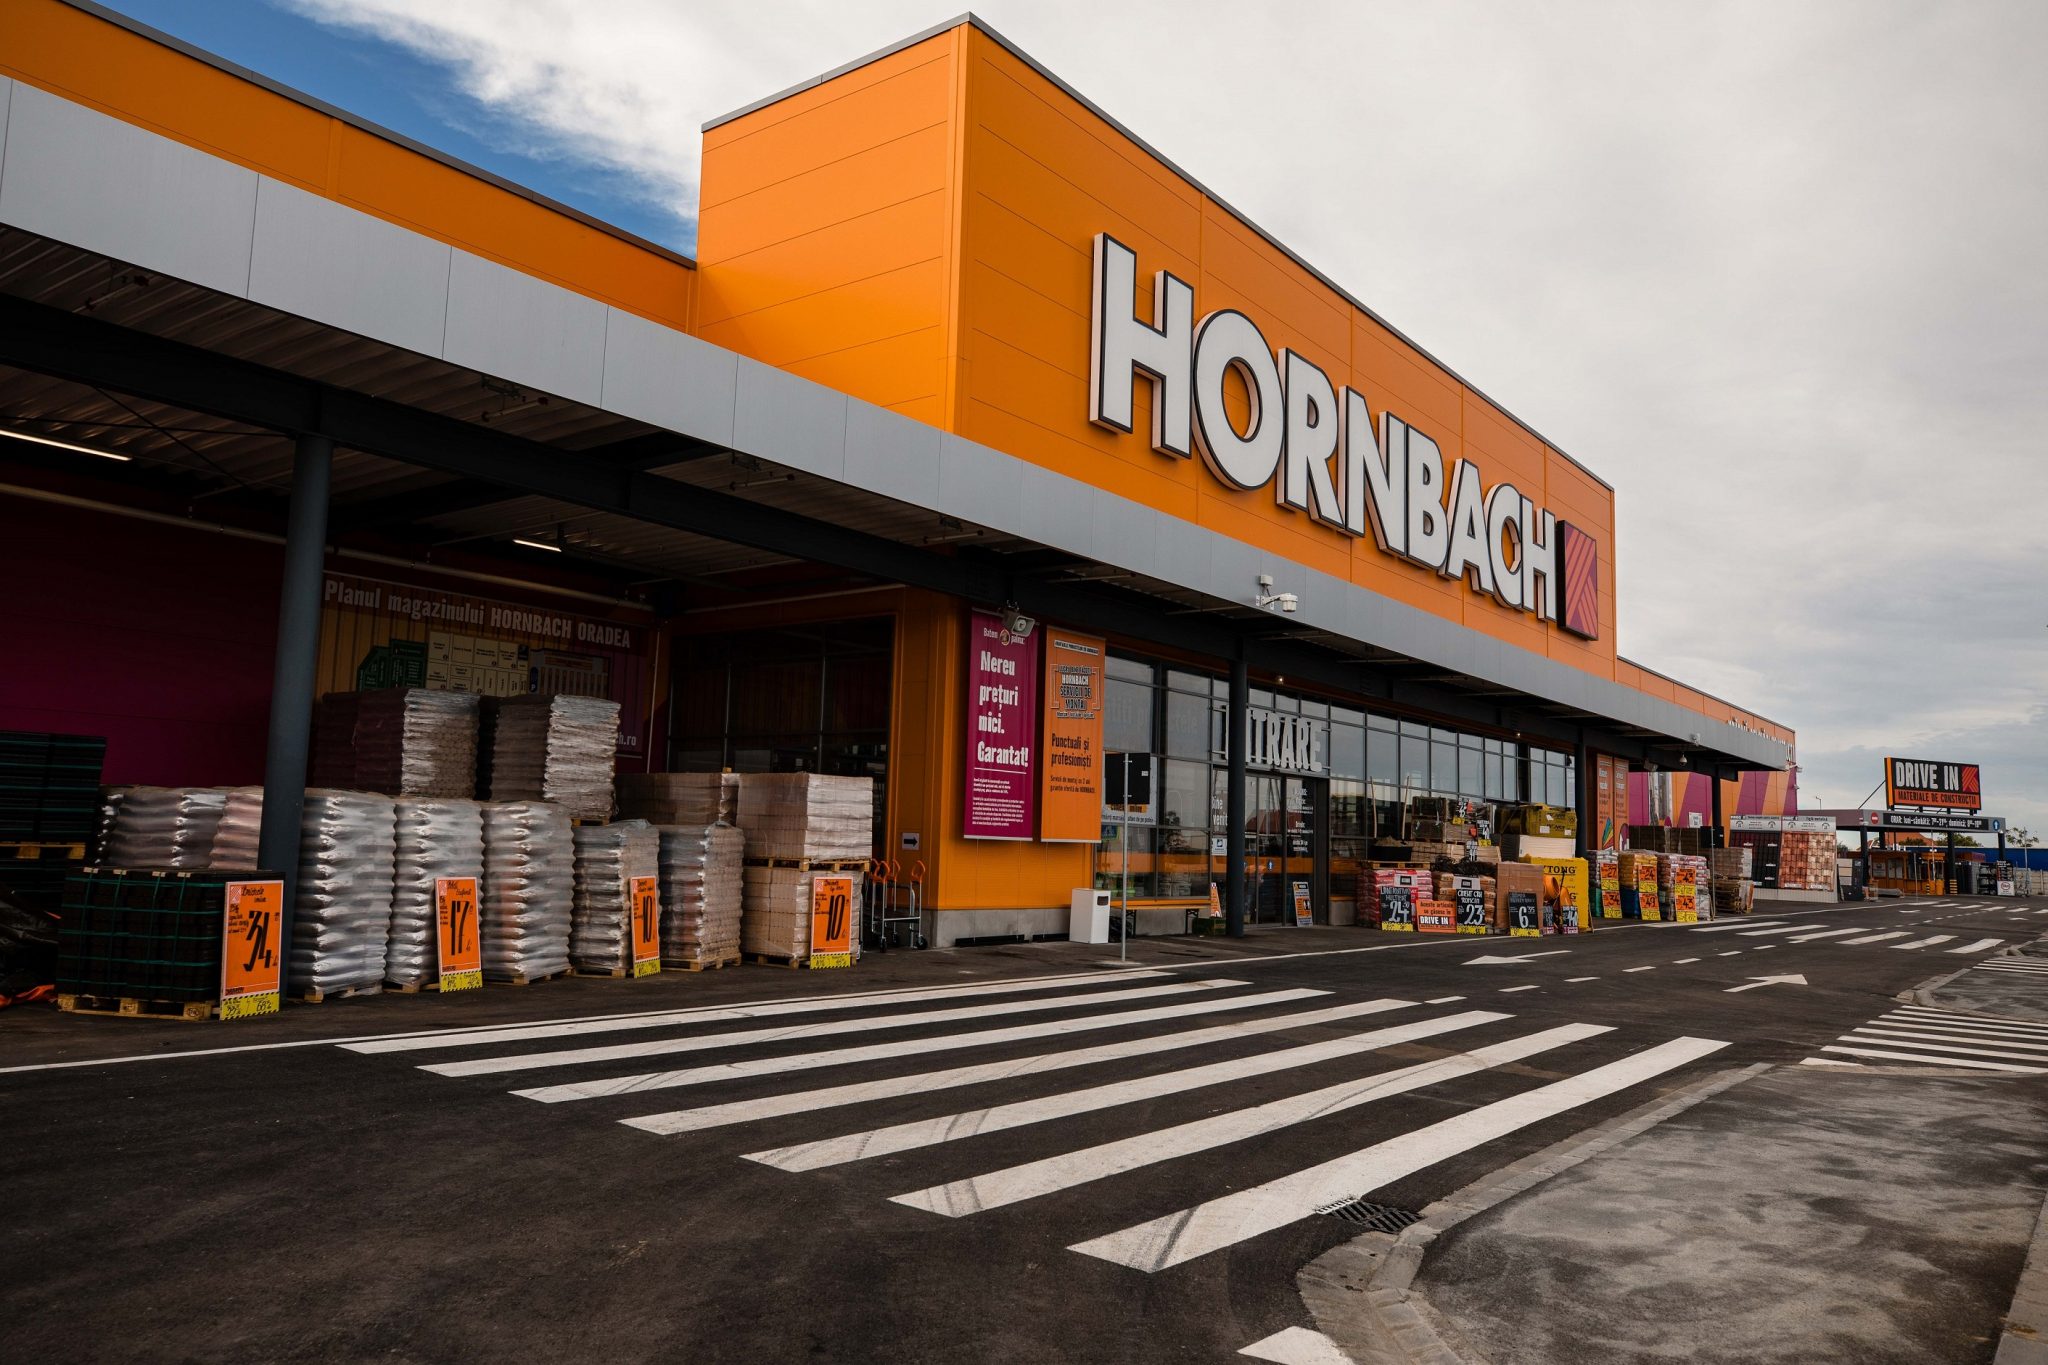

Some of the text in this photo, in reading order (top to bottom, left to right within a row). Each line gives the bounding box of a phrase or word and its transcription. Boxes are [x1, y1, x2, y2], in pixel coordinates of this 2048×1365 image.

[1090, 232, 1558, 622] HORNBACH
[325, 580, 631, 648] Planul magazinului HORNBACH ORADEA
[979, 684, 1019, 710] prețuri
[978, 711, 1005, 734] mici.
[1051, 732, 1081, 750] Punctuali
[1226, 704, 1323, 773] TRARE
[977, 740, 1029, 768] Garantat!
[1051, 751, 1091, 770] profesioniști
[1896, 761, 1959, 791] DRIVE IN
[1898, 791, 1929, 801] MATERIALE
[1931, 793, 1938, 803] DE
[1543, 866, 1576, 874] TONG
[643, 895, 653, 943] 10
[826, 894, 845, 941] 10
[1389, 900, 1409, 922] 24
[1420, 916, 1448, 925] DRIVE IN
[1464, 904, 1484, 925] 23
[1519, 906, 1528, 928] 6
[451, 901, 469, 955] 17
